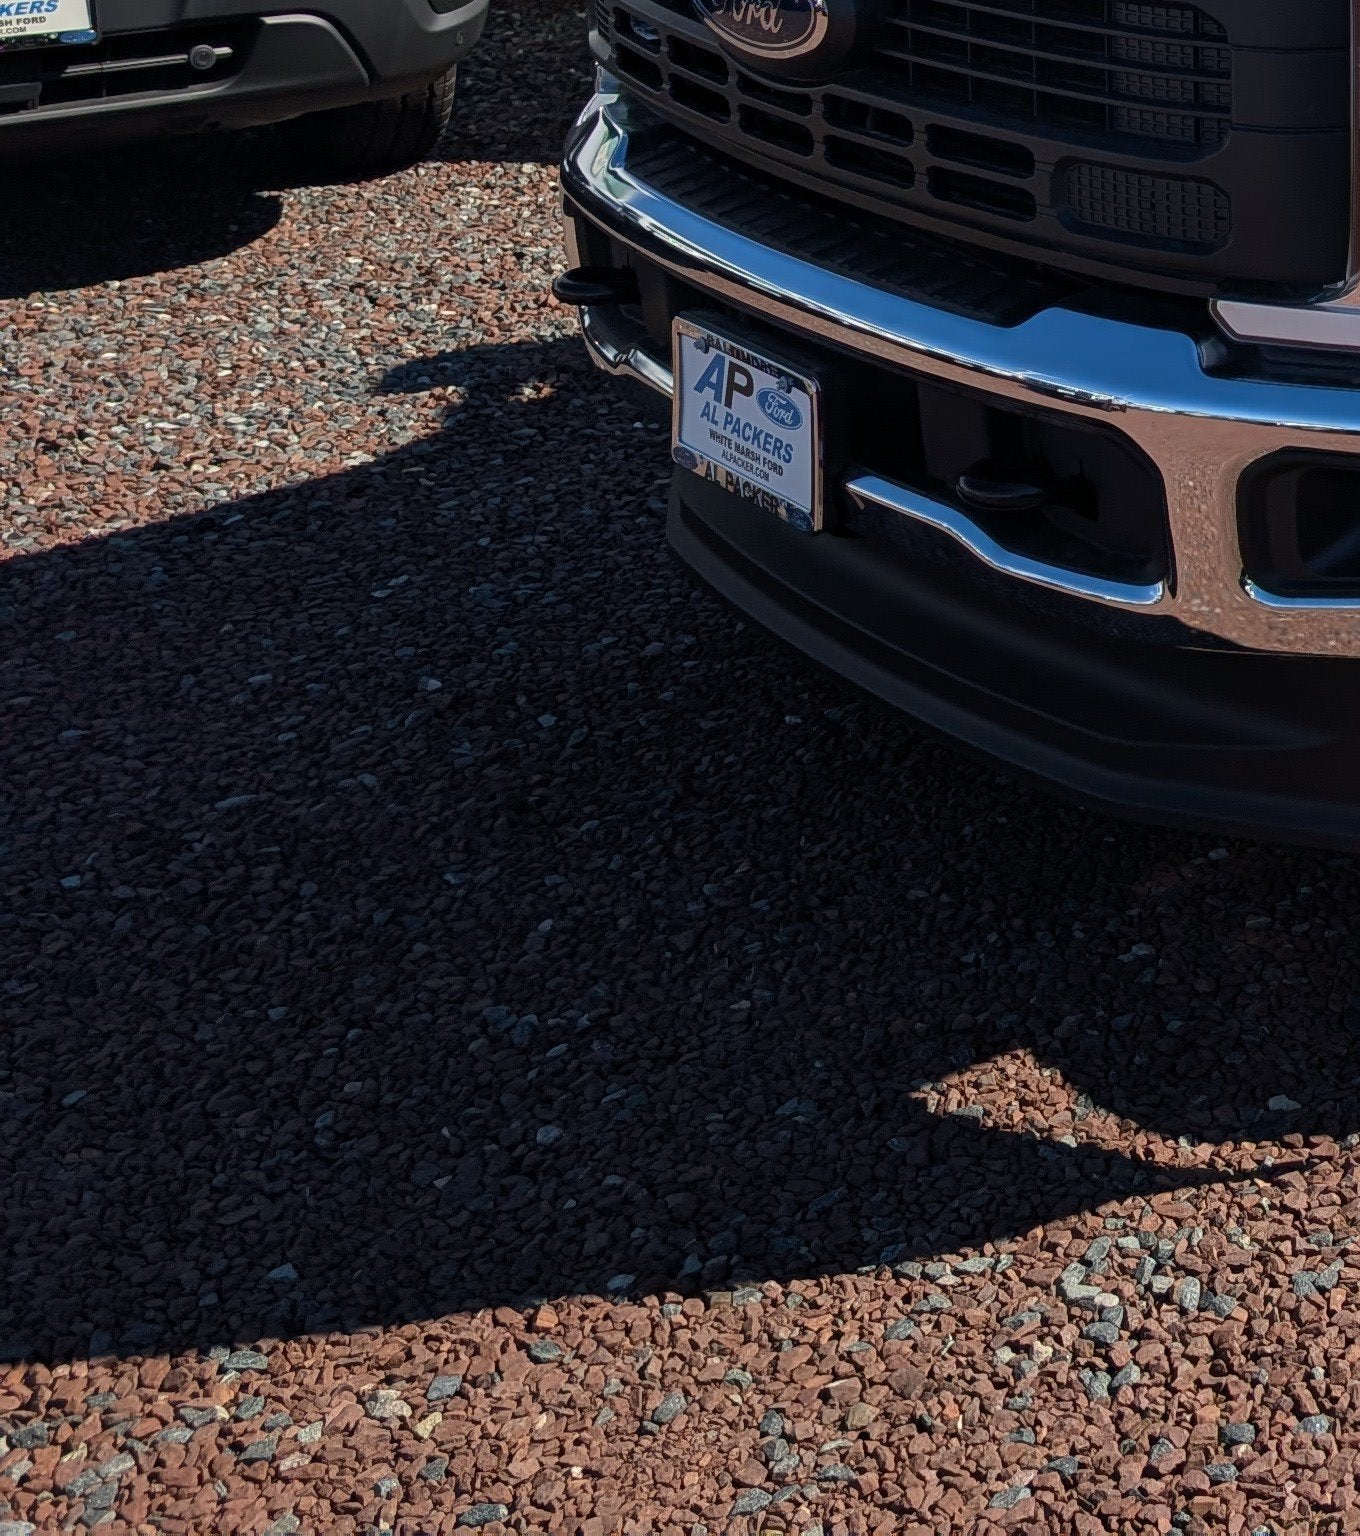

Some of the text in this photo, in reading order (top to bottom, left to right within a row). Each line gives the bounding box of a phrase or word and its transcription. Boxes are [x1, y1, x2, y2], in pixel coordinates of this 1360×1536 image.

[16, 16, 47, 26] FORD
[693, 353, 754, 410] AP
[765, 392, 794, 425] Ford
[700, 401, 719, 426] AL
[723, 412, 794, 464] PACKERS
[709, 428, 784, 477] WHITE MARSH FORD
[721, 449, 770, 482] ALPACKER.COM
